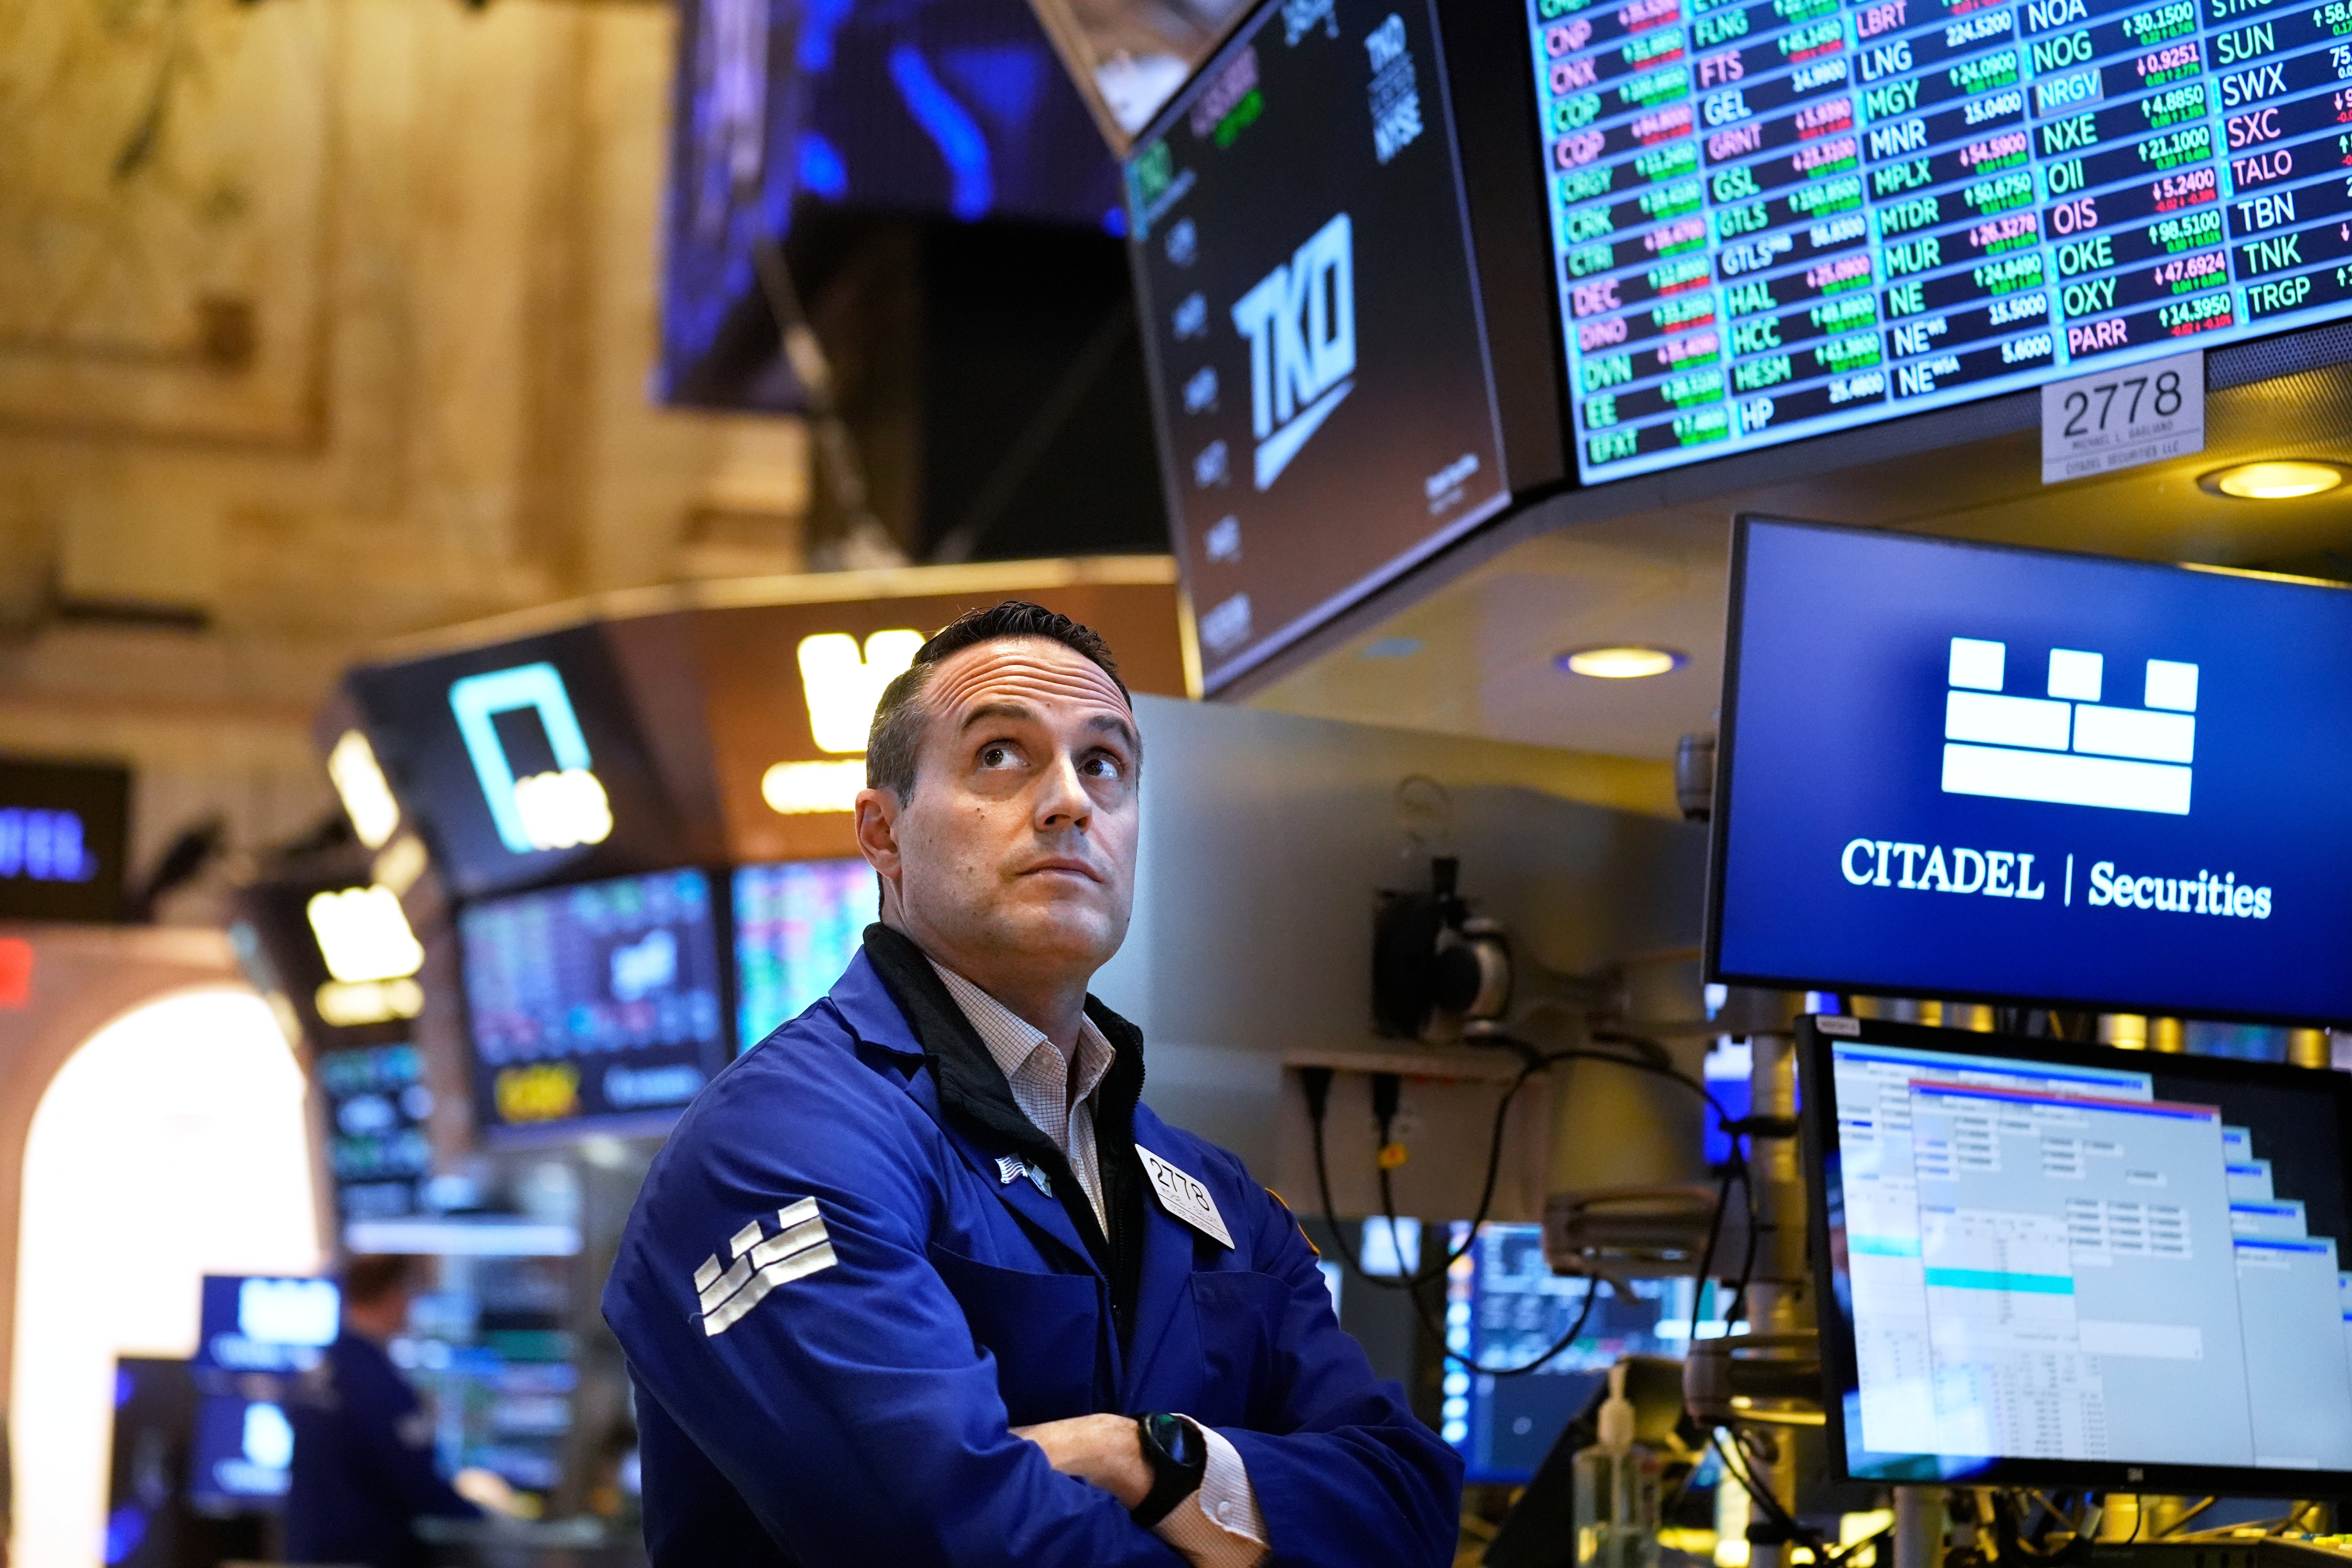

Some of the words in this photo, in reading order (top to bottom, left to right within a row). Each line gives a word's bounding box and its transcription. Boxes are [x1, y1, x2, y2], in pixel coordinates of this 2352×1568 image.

[1694, 9, 1749, 46] FLNG
[1857, 2, 1907, 38] LBRT
[2028, 0, 2088, 32] NOA
[2033, 29, 2093, 73] NOG
[2132, 0, 2193, 35] 30.1500
[1861, 40, 1912, 81] LNG
[2217, 21, 2274, 64] SUN
[1700, 50, 1744, 87] FTS
[2038, 69, 2099, 110] NRGV
[2146, 43, 2200, 73] 0.9251
[2222, 62, 2287, 106] SWX
[1704, 90, 1752, 125] GEL
[1866, 78, 1919, 120] MGY
[2043, 113, 2098, 154] NXE
[2152, 84, 2204, 114] 4.8850
[1870, 118, 1927, 160] MNR
[1965, 91, 2022, 124] 15.0400
[2228, 107, 2281, 148] SXC
[1875, 157, 1932, 195] MPLX
[2048, 157, 2084, 193] OII
[2149, 125, 2209, 160] 21.1000
[2233, 149, 2293, 186] TALO
[1713, 166, 1761, 202] GSL
[2053, 198, 2098, 234] OIS
[2163, 168, 2215, 196] 5.2400
[1719, 201, 1768, 236] GTLS
[1881, 196, 1940, 235] MTDR
[2237, 191, 2296, 232] TBN
[1884, 237, 1941, 278] MUR
[2059, 234, 2115, 275] OKE
[2159, 209, 2220, 243] 98.5100
[2243, 233, 2302, 274] TNK
[1730, 280, 1777, 317] HAL
[1888, 281, 1926, 317] NE
[2064, 276, 2117, 316] OXY
[2165, 251, 2226, 281] 47.6924
[2249, 276, 2311, 313] TRGP
[1230, 211, 1356, 439] TKO
[1989, 292, 2047, 325] 15.5000
[2069, 318, 2128, 354] PARR
[2170, 292, 2231, 325] 14.3950
[1733, 316, 1782, 355] HCC
[2002, 334, 2052, 363] 5.6000
[1741, 397, 1774, 432] HP
[2063, 370, 2182, 438] 2778
[1841, 838, 2045, 900] CITADEL
[2089, 861, 2272, 919] Securities
[1150, 1158, 1210, 1211] 2778
